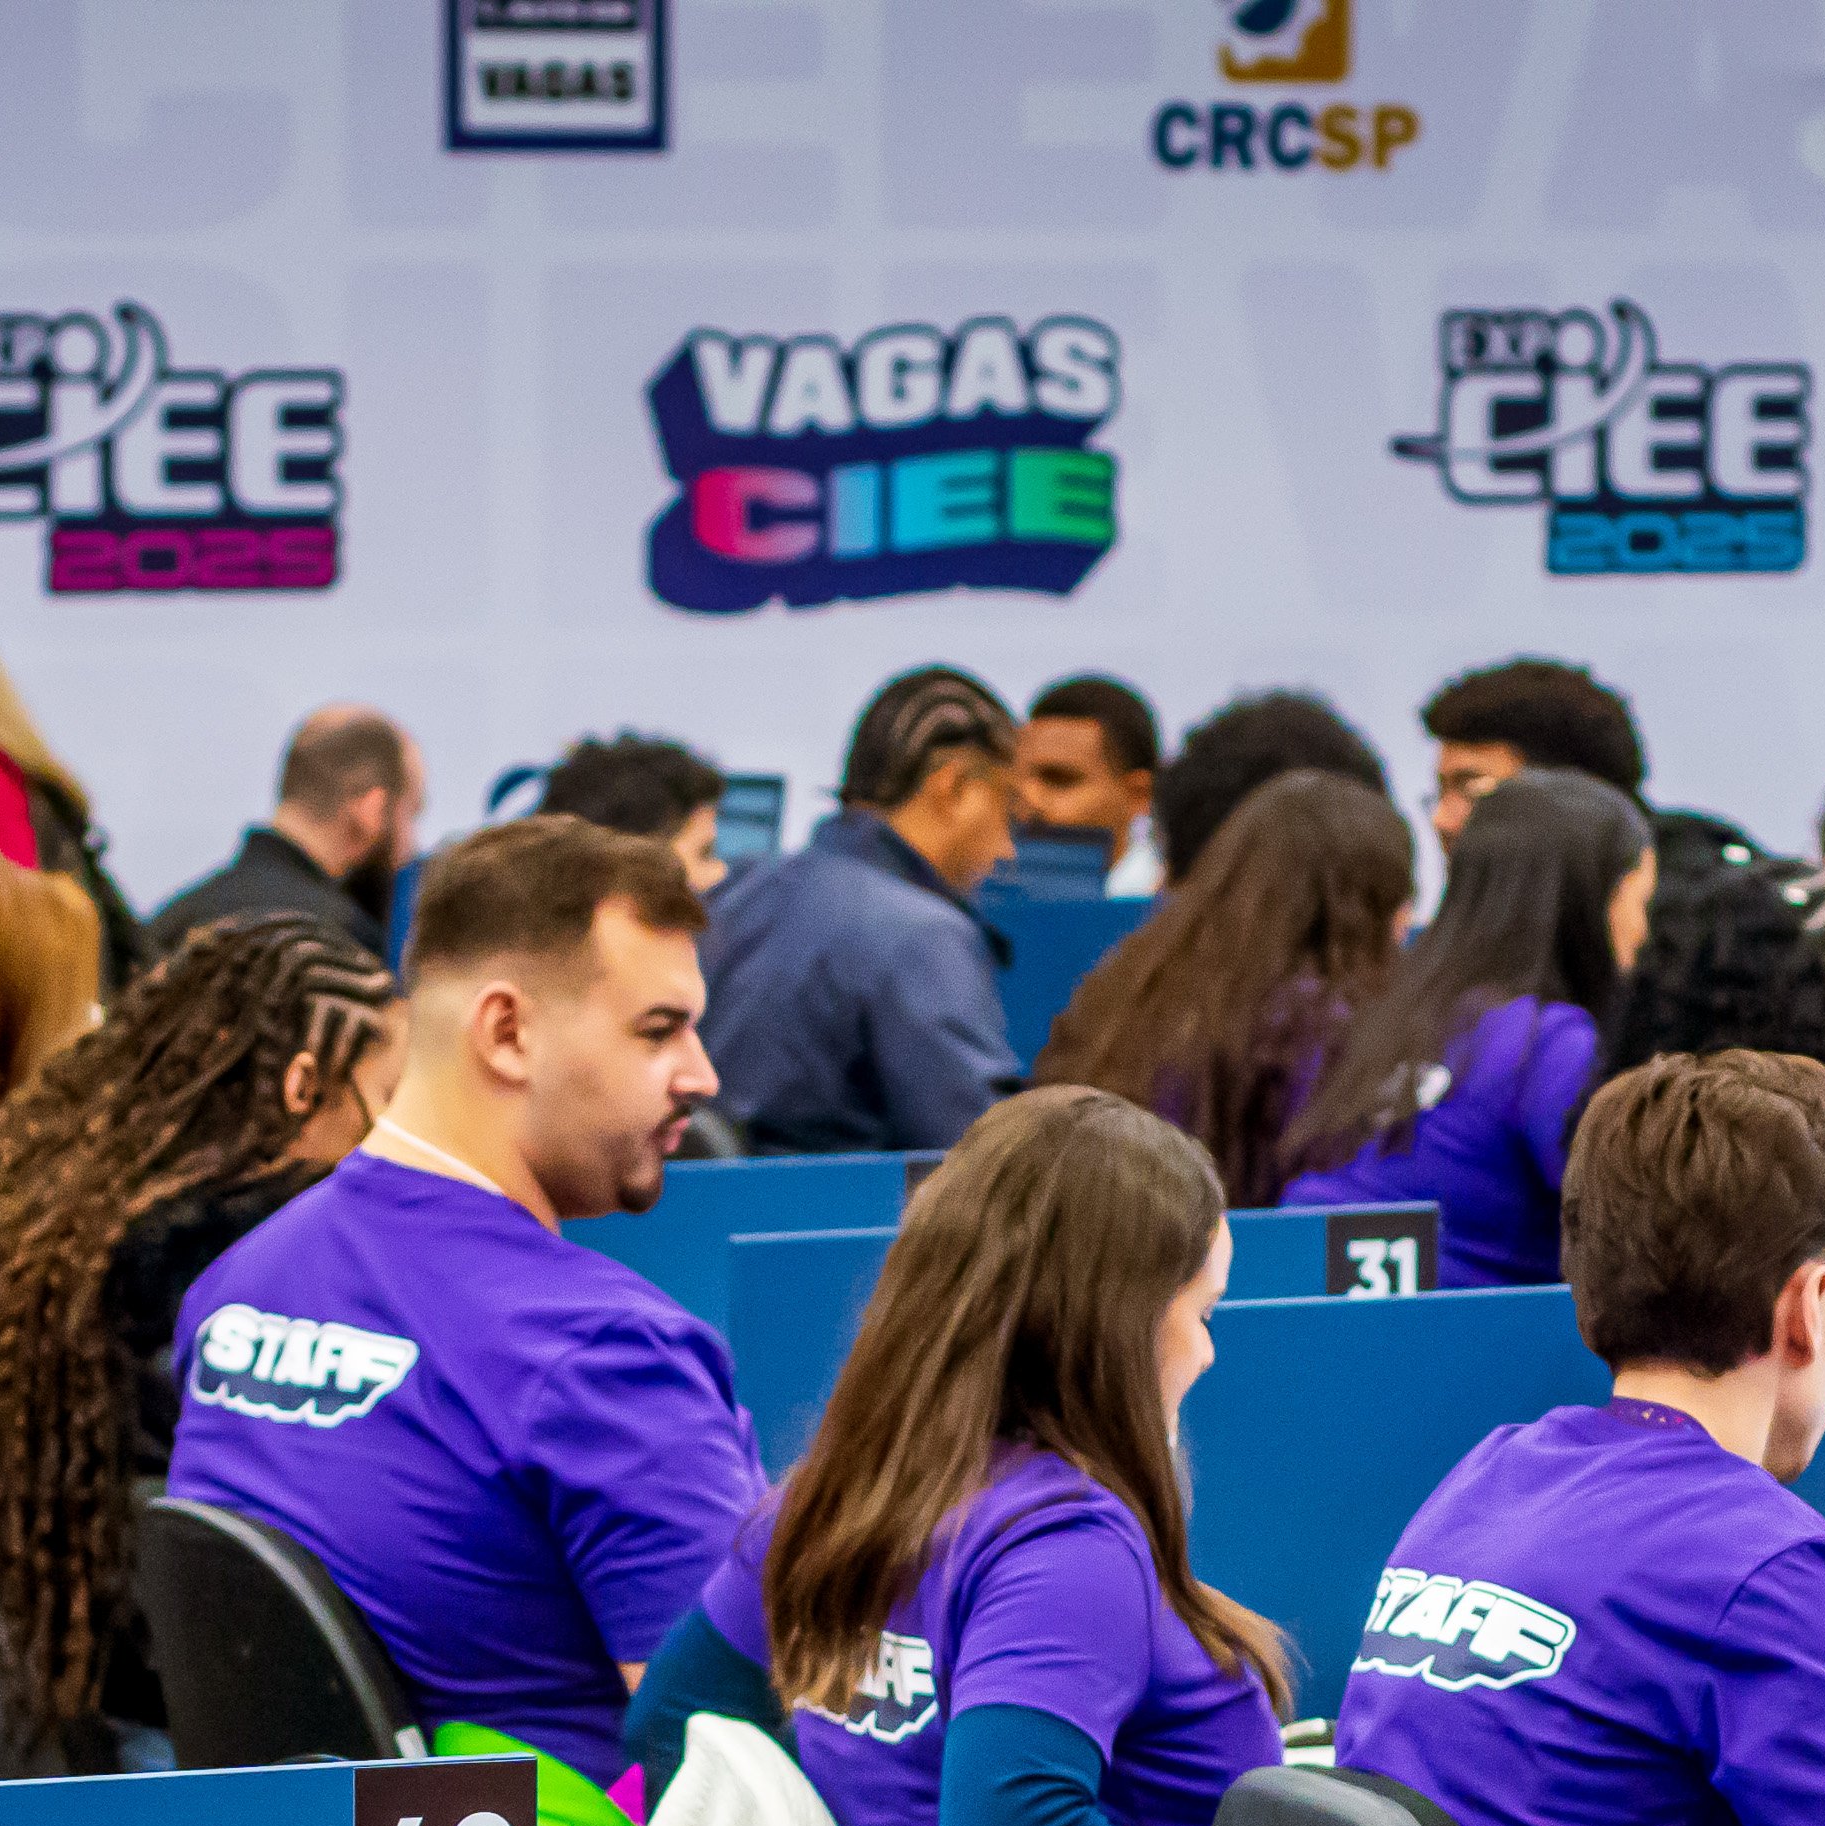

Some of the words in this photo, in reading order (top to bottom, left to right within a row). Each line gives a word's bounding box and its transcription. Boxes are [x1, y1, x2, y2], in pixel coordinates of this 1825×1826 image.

[478, 58, 634, 101] VAGAS
[1153, 103, 1421, 171] CRCSP
[693, 325, 1116, 436] VAGAS
[1448, 374, 1804, 499] CIEE
[692, 445, 1115, 565] CIEE
[50, 527, 337, 591] 2025
[1347, 1235, 1419, 1300] 31
[201, 1310, 413, 1395] STAFF
